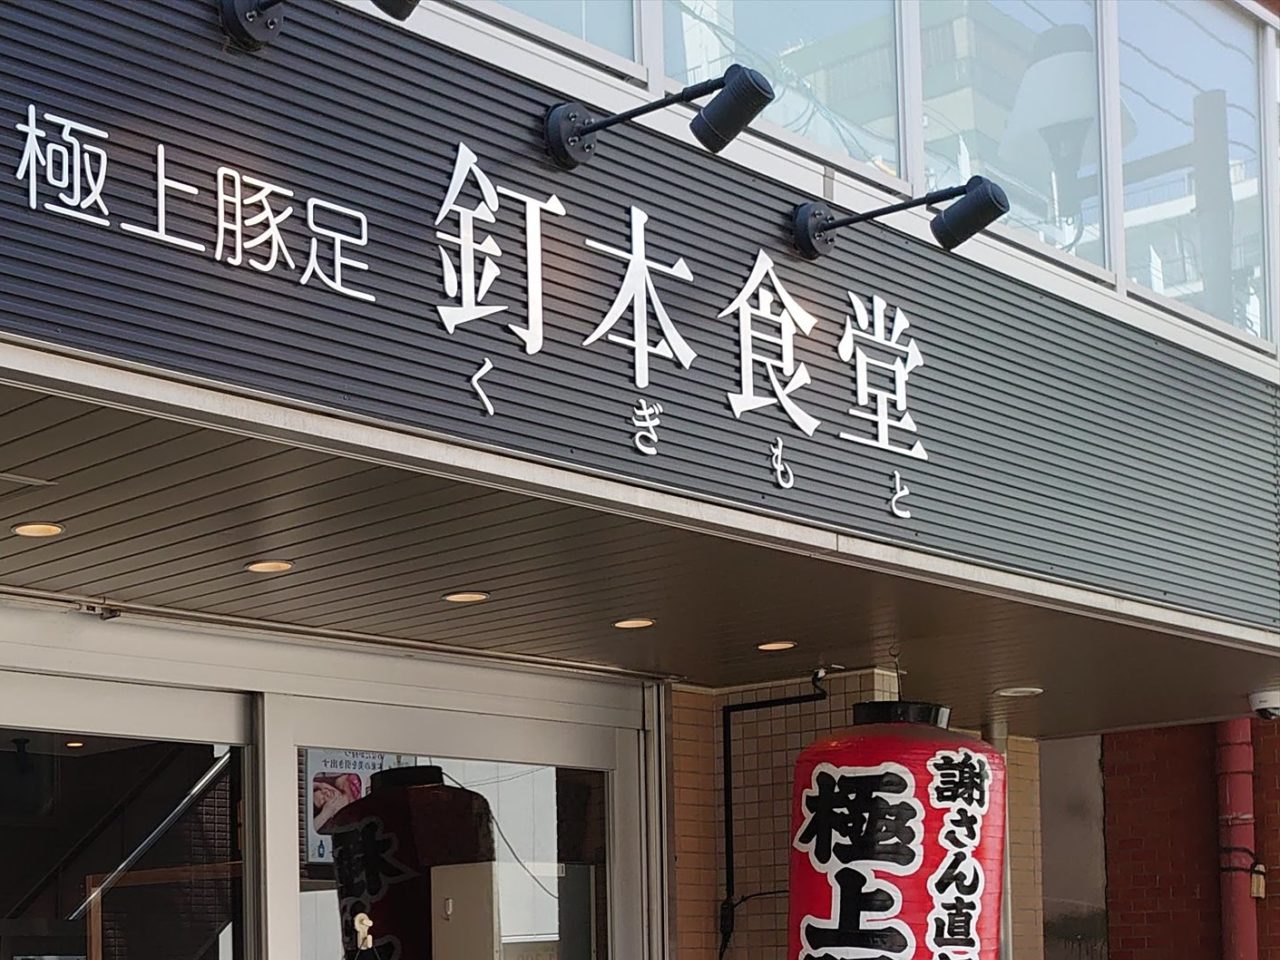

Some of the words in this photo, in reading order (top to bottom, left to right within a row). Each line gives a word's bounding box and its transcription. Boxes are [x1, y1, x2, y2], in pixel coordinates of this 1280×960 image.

[16, 104, 376, 302] 極上豚足
[435, 141, 928, 460] 釘本食堂
[471, 357, 912, 518] くぎもと
